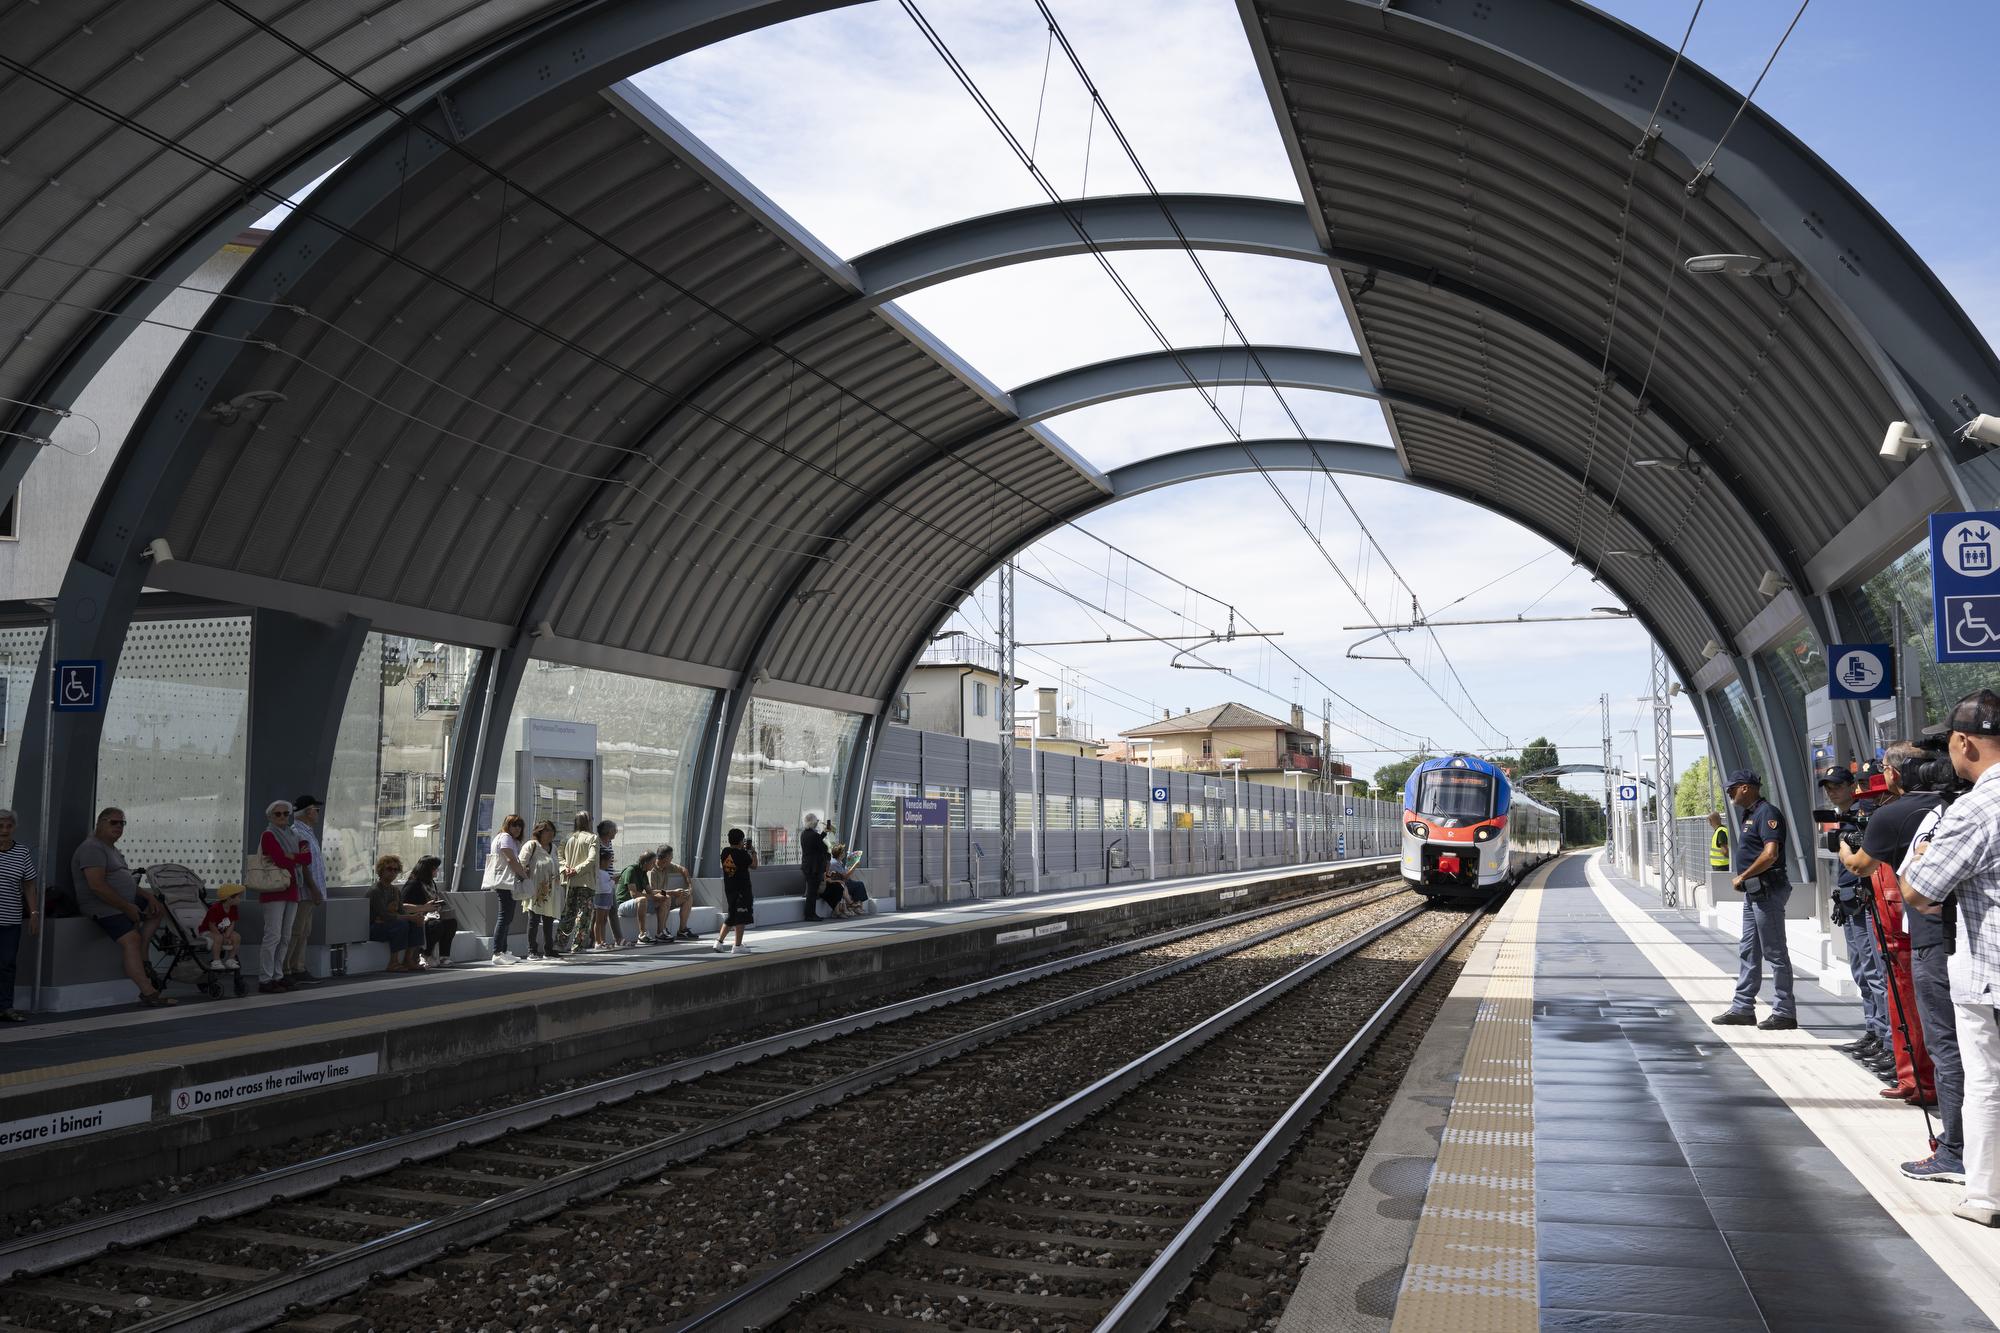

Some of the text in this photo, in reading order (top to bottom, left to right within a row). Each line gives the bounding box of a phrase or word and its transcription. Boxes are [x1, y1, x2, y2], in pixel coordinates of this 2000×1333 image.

[1157, 790, 1163, 798] 2
[194, 1064, 349, 1104] Do not cross the railway lines
[0, 1110, 102, 1145] ersare i binari
